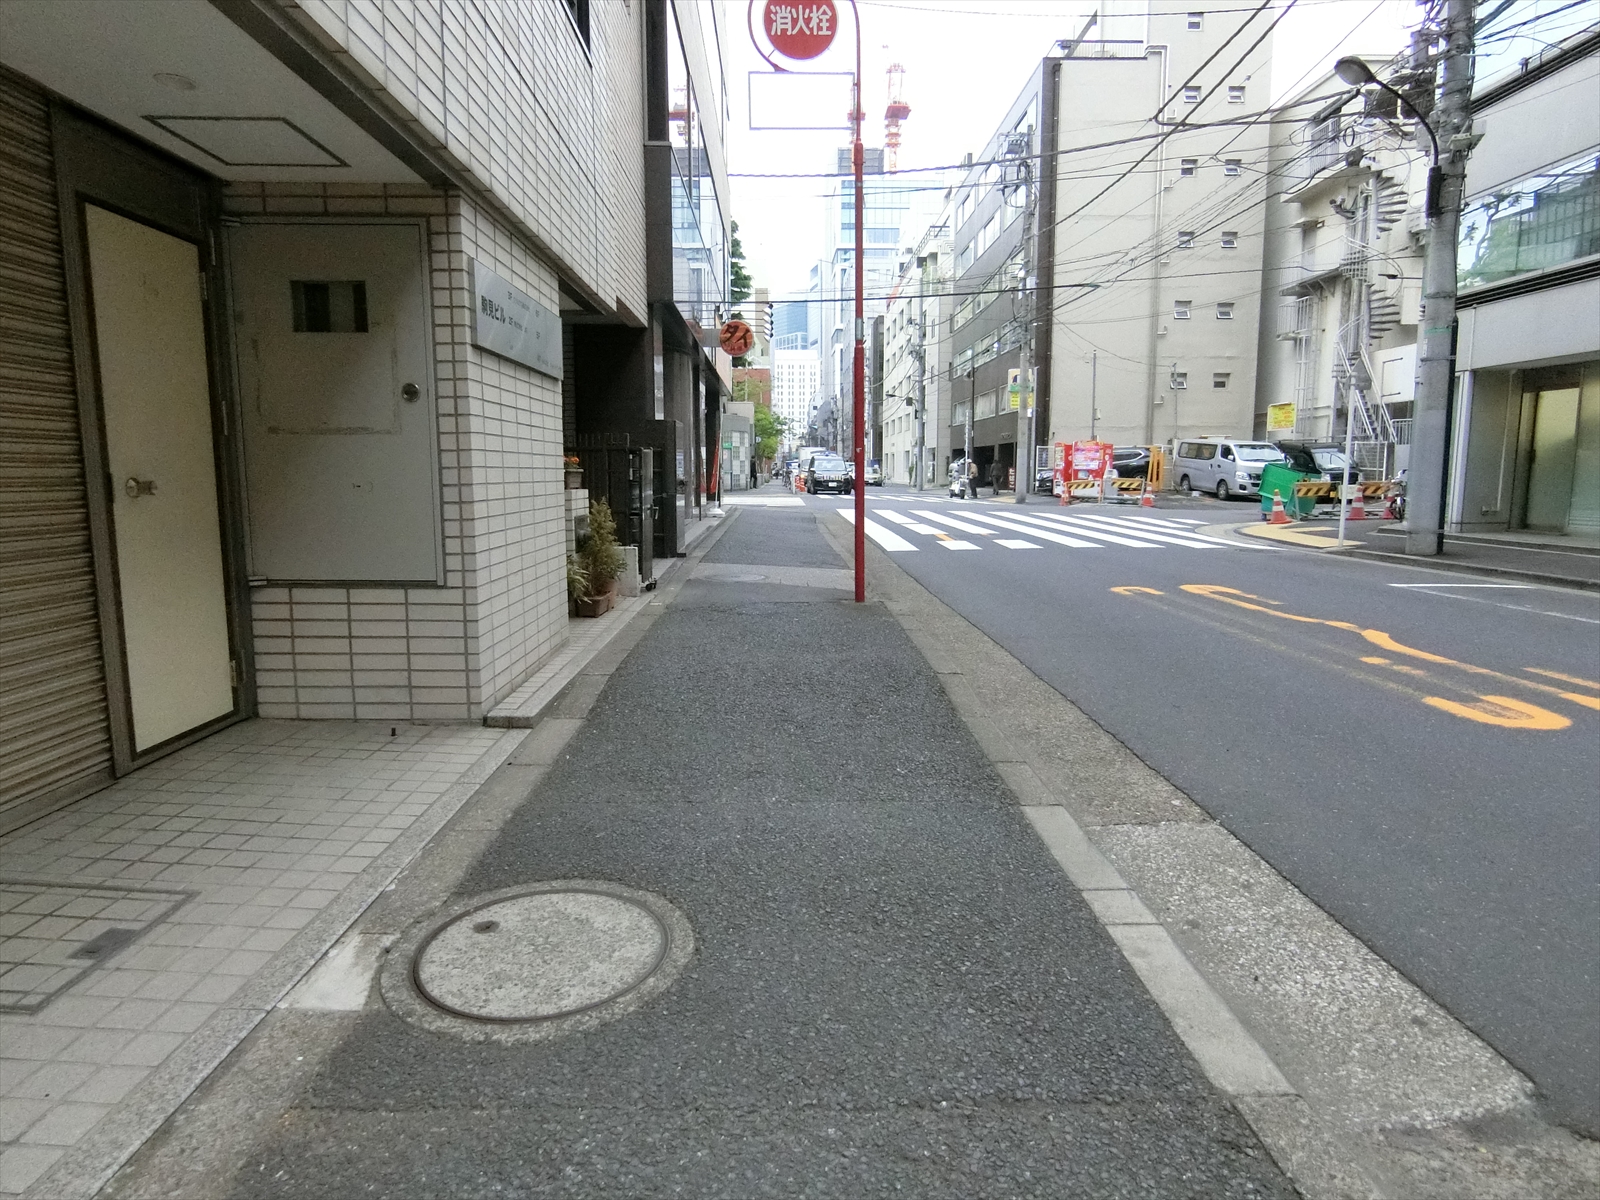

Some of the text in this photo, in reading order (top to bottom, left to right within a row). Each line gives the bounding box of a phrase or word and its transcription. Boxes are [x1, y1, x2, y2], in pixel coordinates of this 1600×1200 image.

[770, 4, 832, 36] 消火栓
[723, 323, 751, 349] タイ
